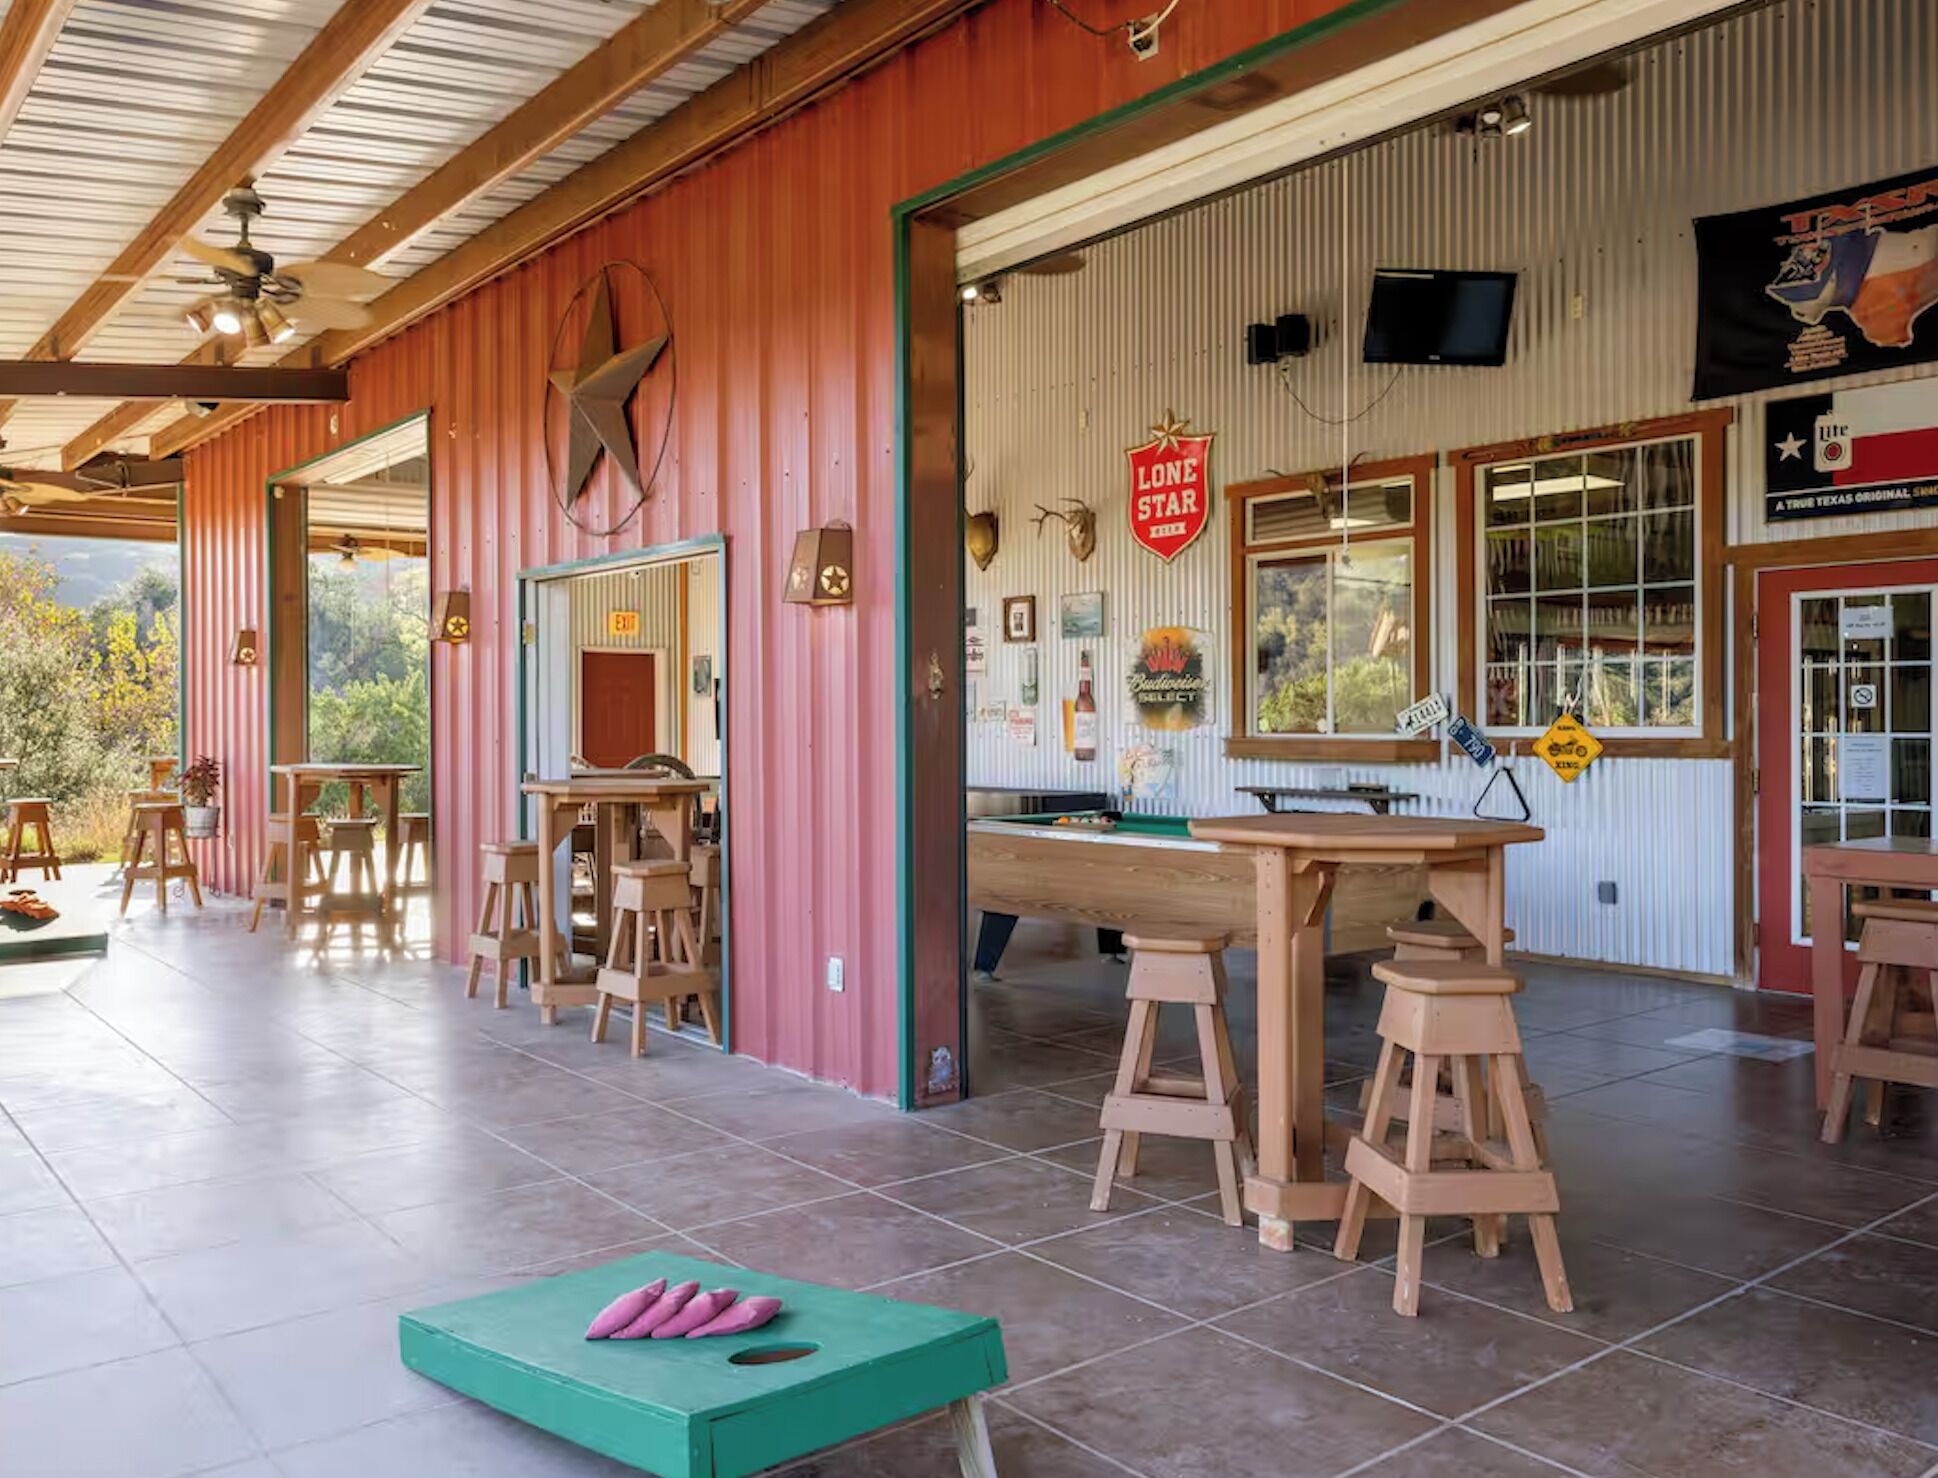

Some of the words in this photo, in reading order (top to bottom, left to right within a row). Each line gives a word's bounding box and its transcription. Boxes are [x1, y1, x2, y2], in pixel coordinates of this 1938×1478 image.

[1820, 424, 1849, 442] Lite
[1138, 458, 1198, 491] LONE
[1138, 488, 1199, 521] STAR
[1775, 500, 1785, 512] A
[1786, 498, 1815, 510] TRUE
[1816, 493, 1853, 507] TEXAS
[616, 614, 636, 631] EXIT
[1127, 672, 1211, 693] Budweiser
[1138, 690, 1197, 703] SELECT
